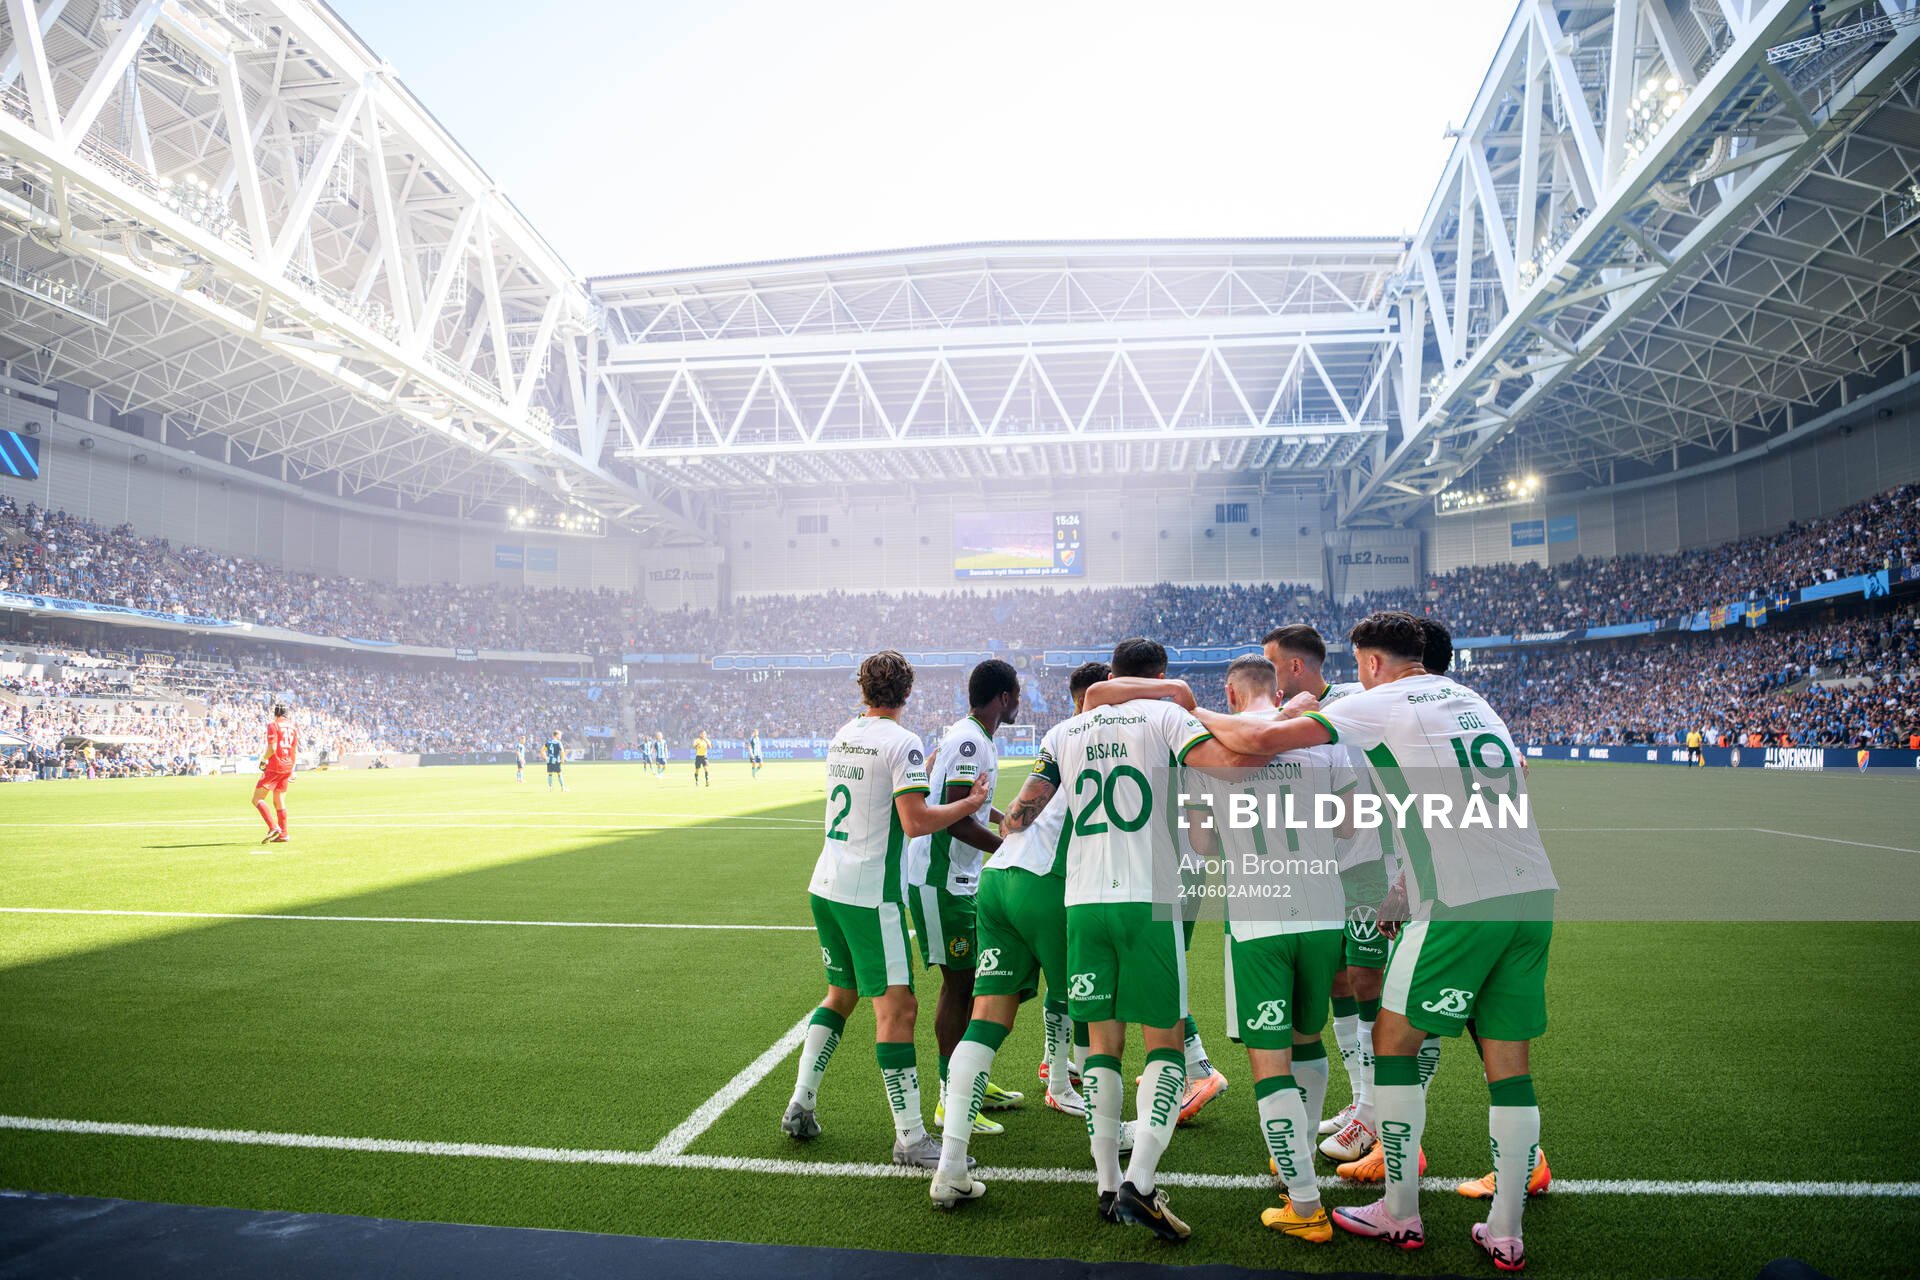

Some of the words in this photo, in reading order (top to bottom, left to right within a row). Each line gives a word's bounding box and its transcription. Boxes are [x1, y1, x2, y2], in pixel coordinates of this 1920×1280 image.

[1337, 551, 1373, 565] TELE2
[1375, 554, 1410, 564] Arena
[1457, 711, 1486, 731] GÜL
[1086, 743, 1128, 761] BISARA
[1764, 748, 1824, 771] ALLSVENSKAN
[1449, 733, 1518, 809] 19
[1075, 765, 1153, 837] 20
[827, 784, 852, 842] 2
